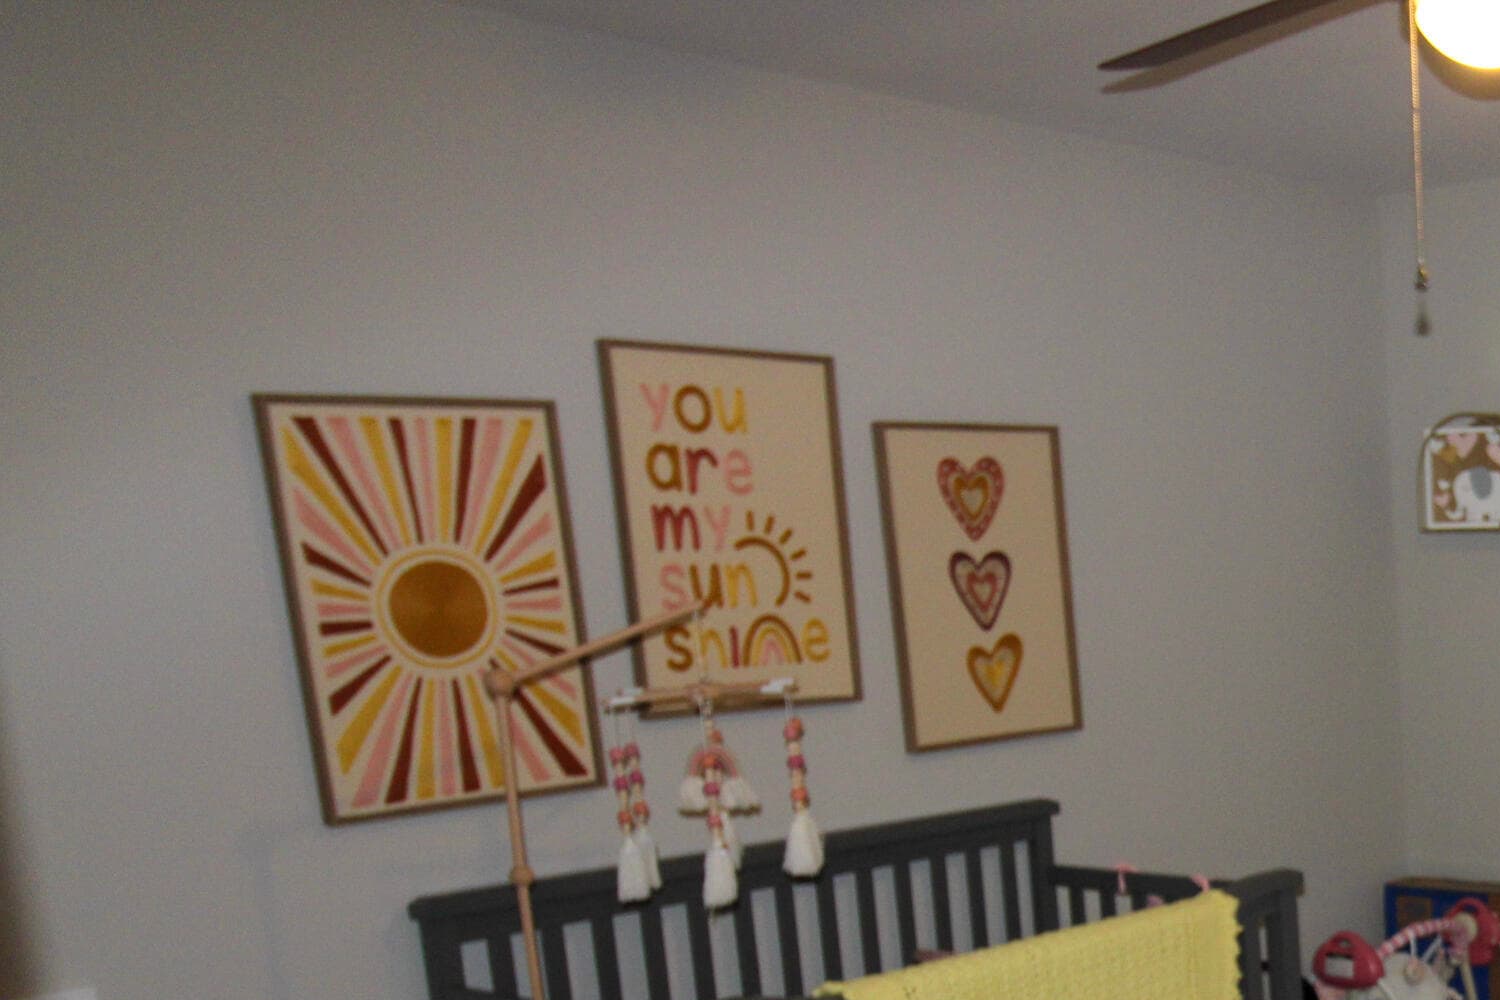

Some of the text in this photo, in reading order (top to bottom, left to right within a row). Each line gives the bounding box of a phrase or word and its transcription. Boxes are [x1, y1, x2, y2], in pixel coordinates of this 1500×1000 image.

[640, 383, 747, 434] you
[646, 443, 753, 495] are
[652, 503, 732, 553] my
[660, 562, 758, 610] sun
